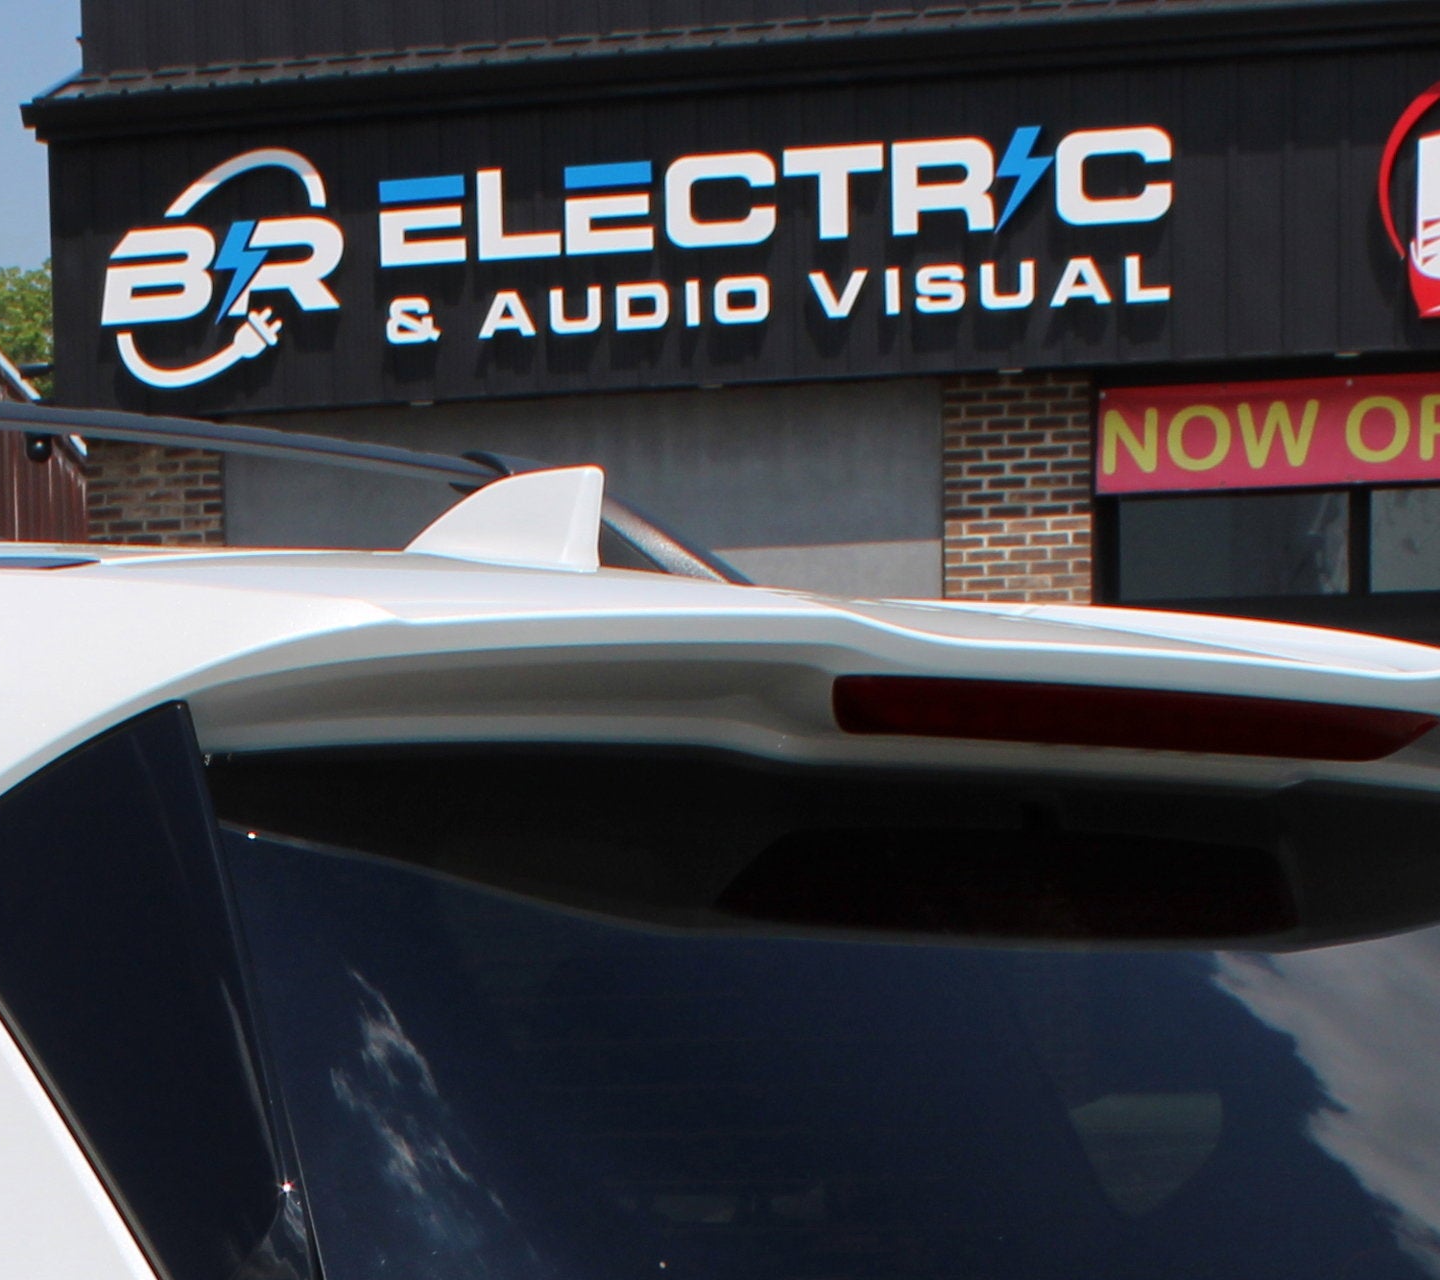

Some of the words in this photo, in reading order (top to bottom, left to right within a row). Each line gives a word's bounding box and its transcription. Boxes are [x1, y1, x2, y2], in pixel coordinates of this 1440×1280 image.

[385, 295, 442, 345] &
[477, 274, 771, 340] AUDIO
[808, 253, 1171, 319] VISUAL
[1101, 399, 1320, 476] NOW
